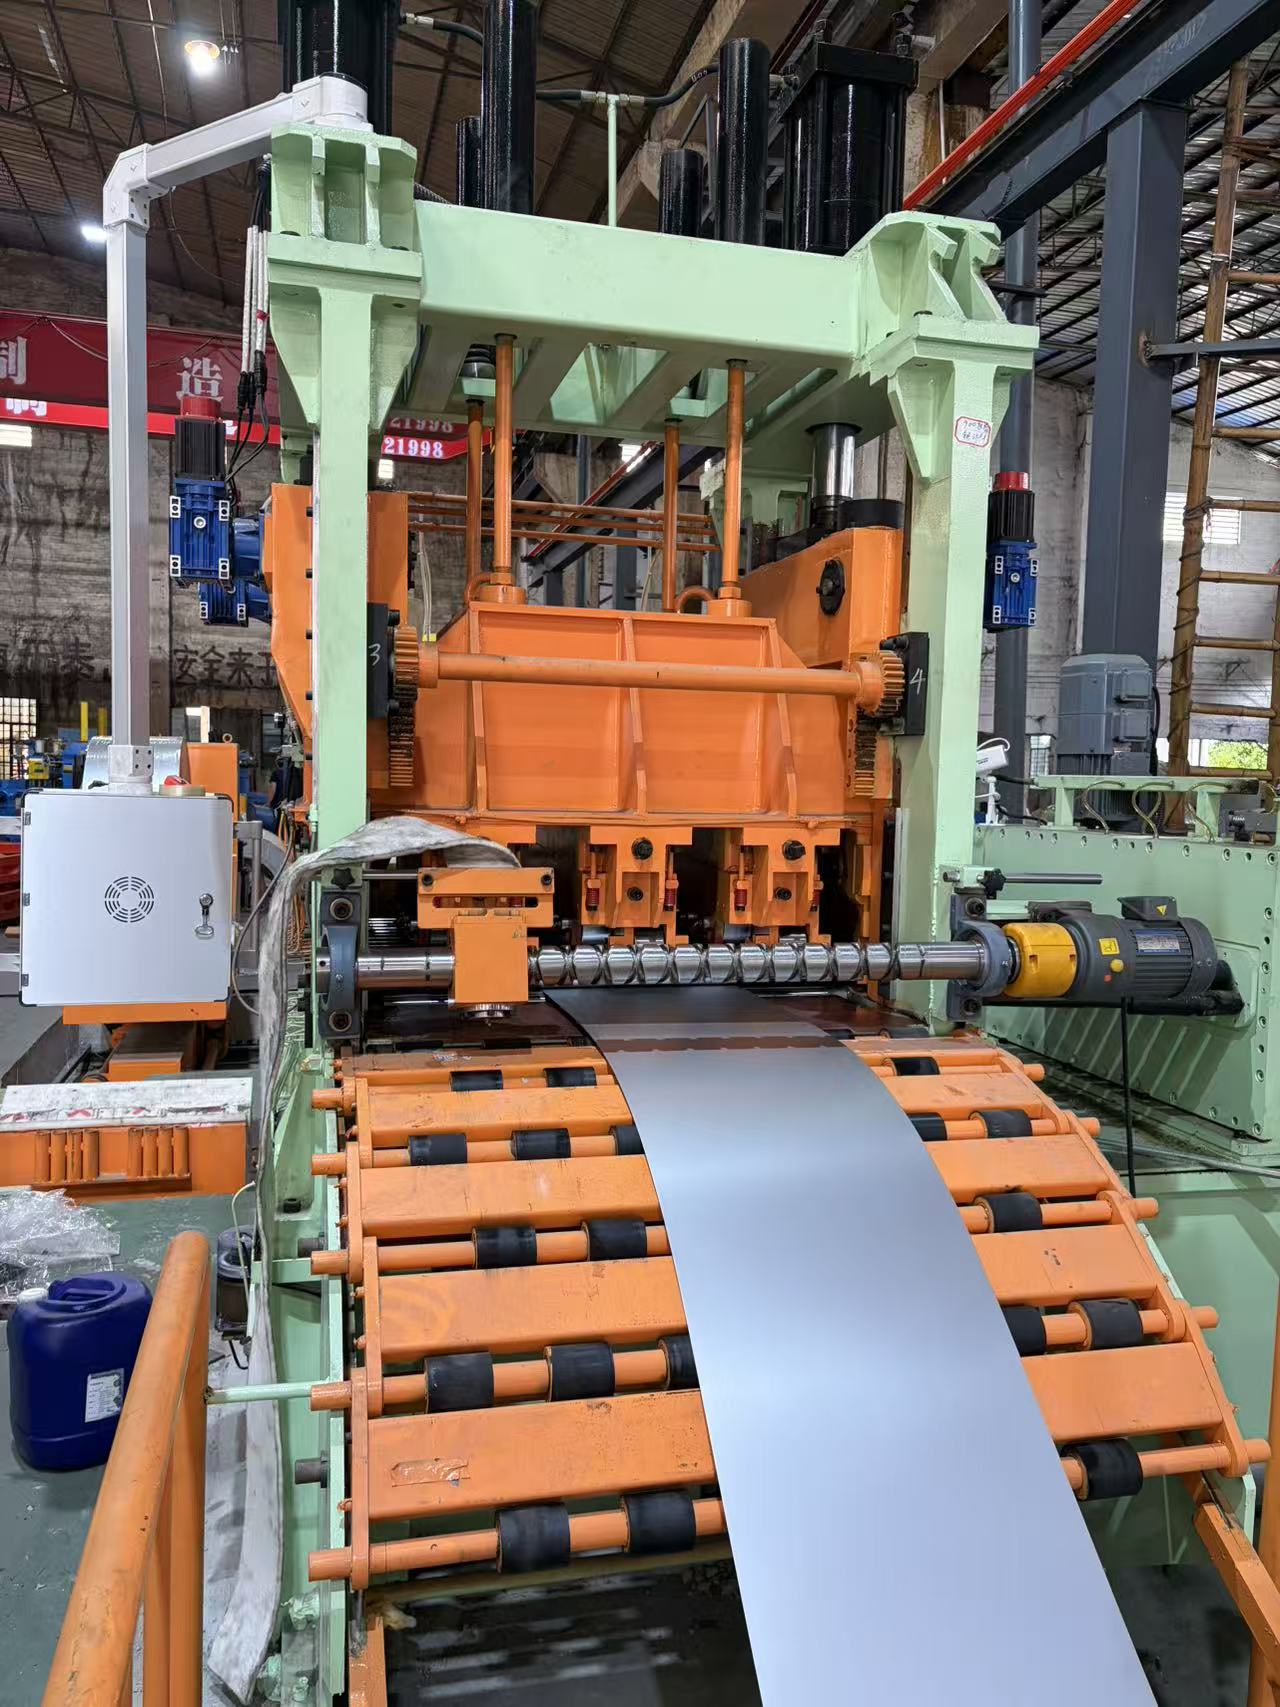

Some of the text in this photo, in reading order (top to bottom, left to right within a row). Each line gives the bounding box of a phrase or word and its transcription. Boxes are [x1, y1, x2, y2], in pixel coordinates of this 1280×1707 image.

[176, 357, 223, 401] 造
[384, 437, 443, 459] 21998
[369, 643, 381, 666] 3
[909, 667, 926, 696] 4
